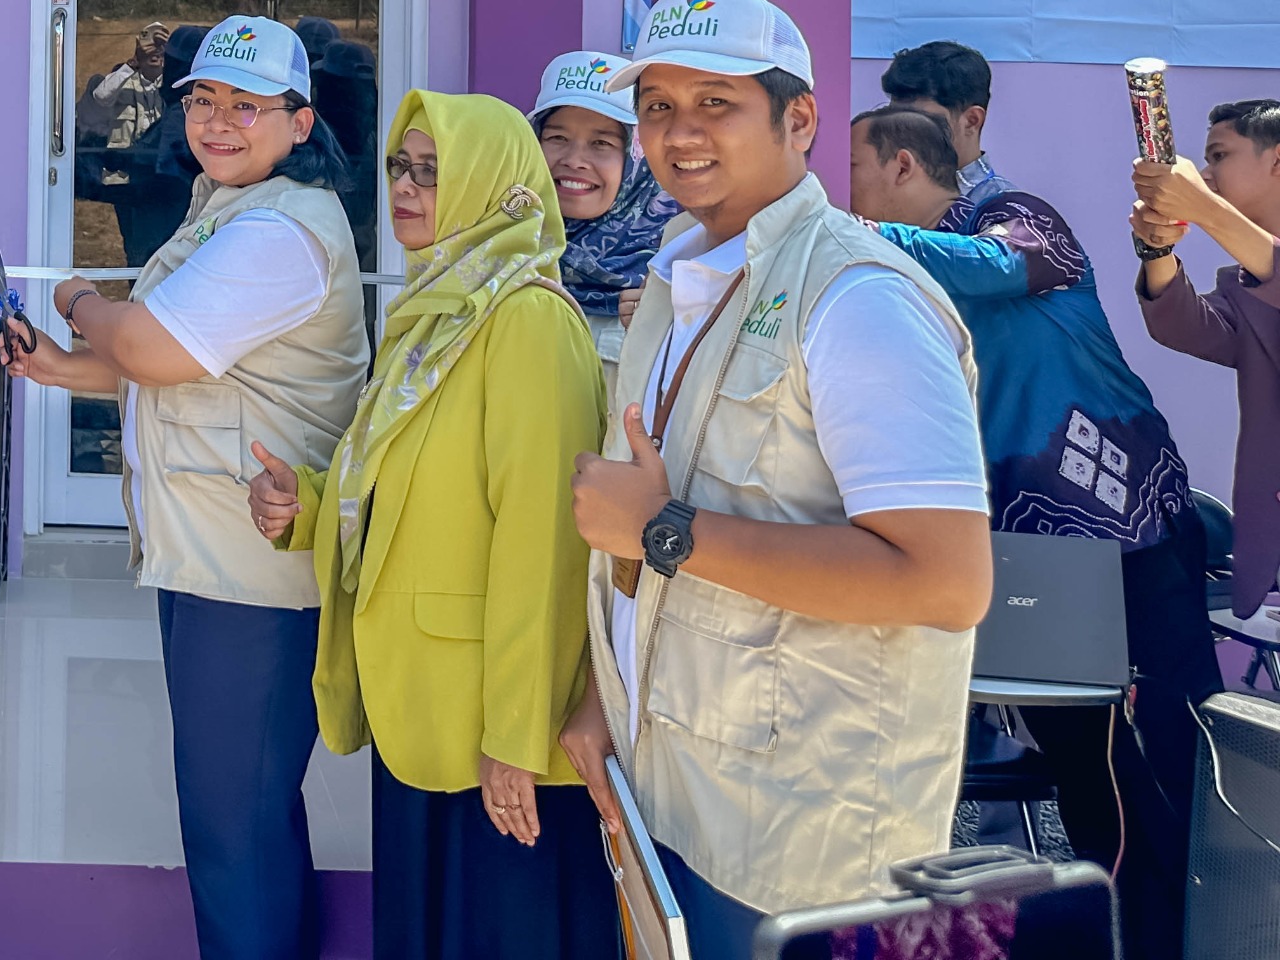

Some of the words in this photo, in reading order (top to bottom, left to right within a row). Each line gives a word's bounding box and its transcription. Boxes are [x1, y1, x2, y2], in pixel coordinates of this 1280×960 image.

[652, 5, 682, 26] PLN
[647, 14, 718, 44] Peduli
[210, 33, 234, 45] PLN
[205, 42, 257, 62] Peduli
[559, 66, 586, 78] PLN
[1007, 596, 1038, 607] acer
